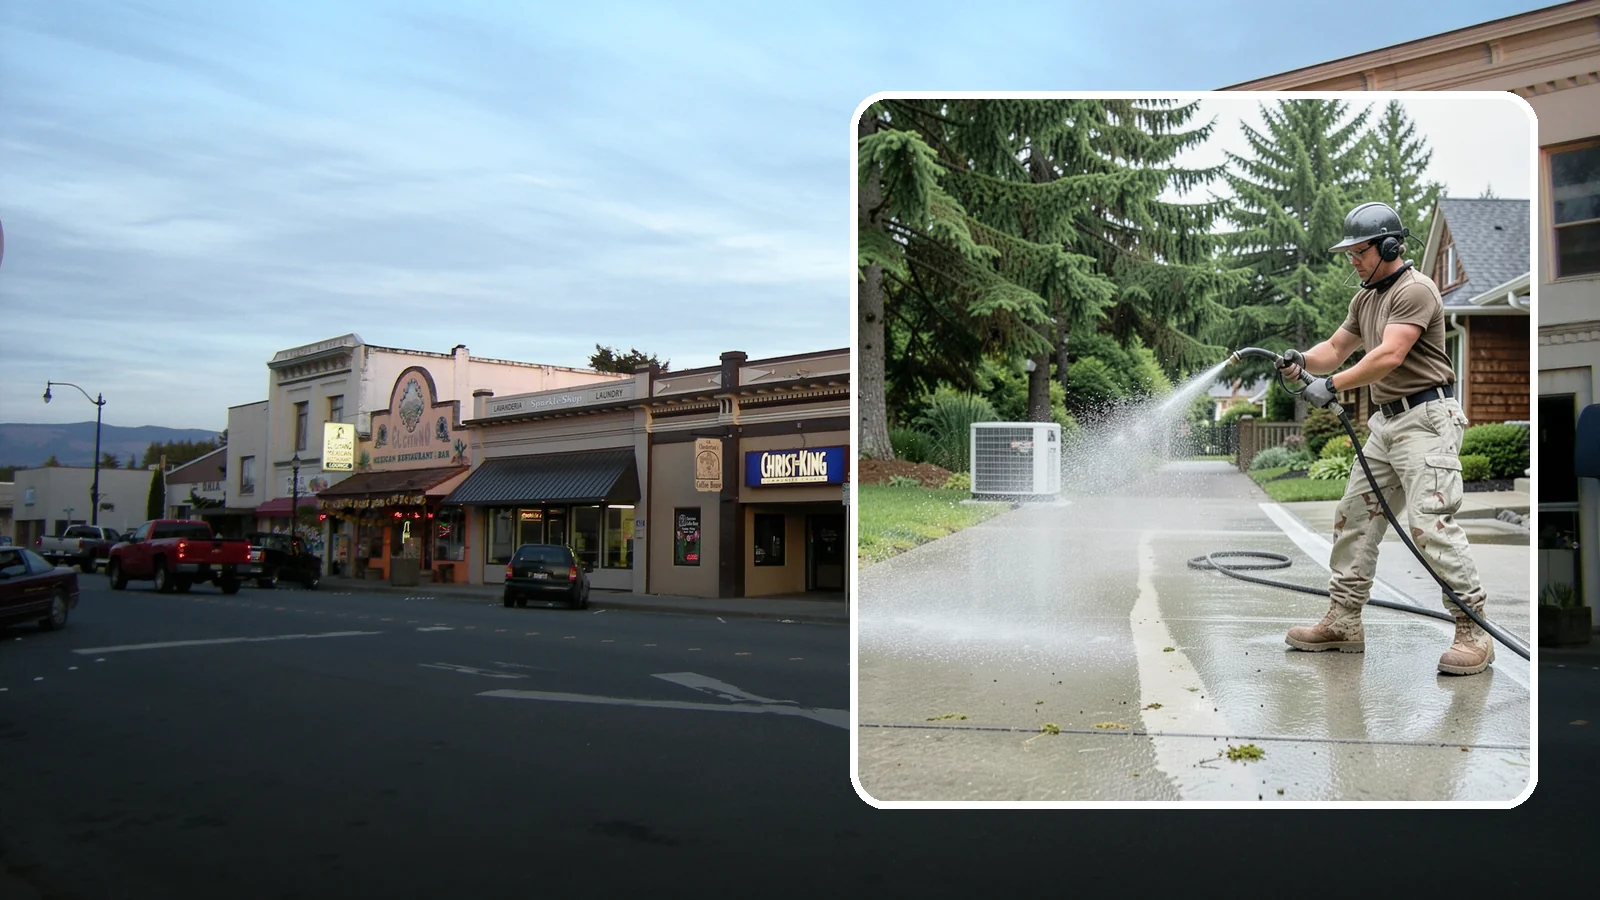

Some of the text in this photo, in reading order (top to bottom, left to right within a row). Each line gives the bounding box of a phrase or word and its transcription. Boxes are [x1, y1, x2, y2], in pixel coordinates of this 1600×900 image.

[531, 394, 582, 409] Sparkle Shop
[595, 389, 623, 400] LAUNDRY
[493, 402, 522, 413] LAVANDERIA
[374, 454, 397, 464] MEXICAN
[398, 451, 433, 463] RESTAURANT
[438, 450, 450, 459] BAR
[761, 450, 827, 478] CHRIST KING
